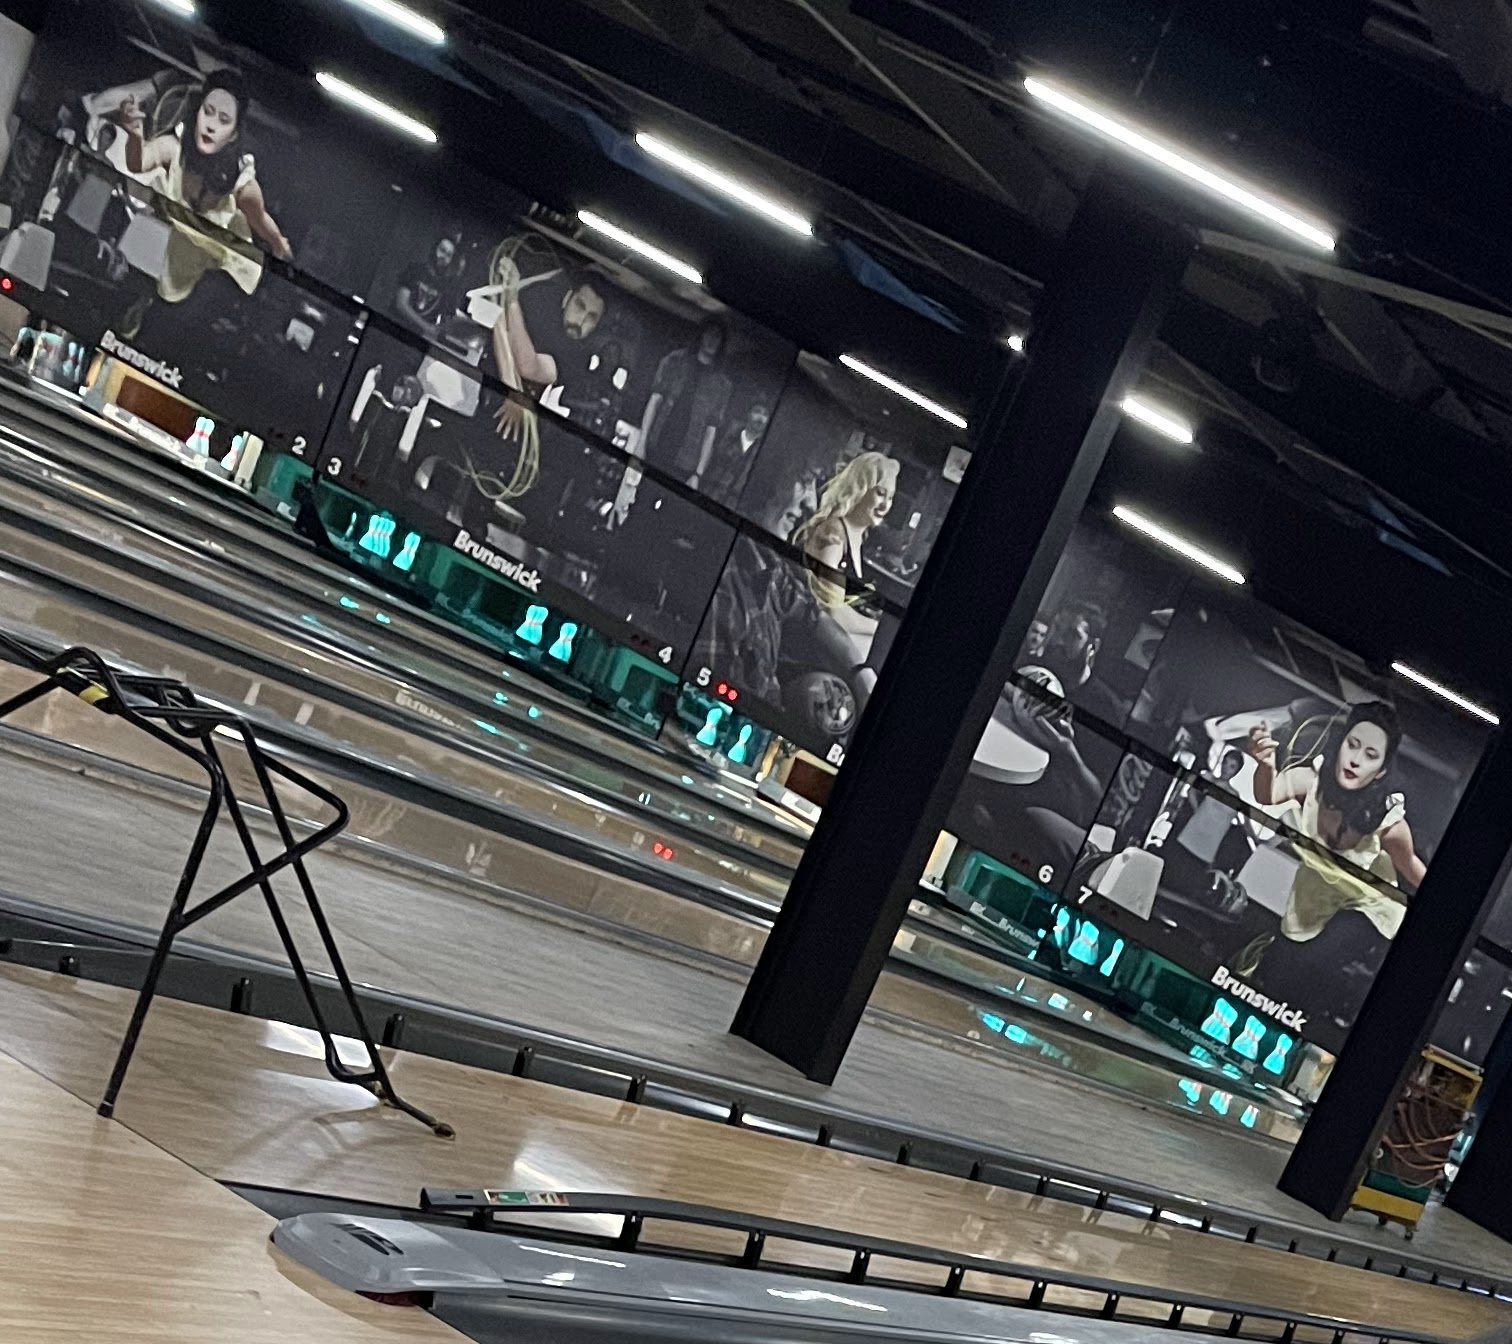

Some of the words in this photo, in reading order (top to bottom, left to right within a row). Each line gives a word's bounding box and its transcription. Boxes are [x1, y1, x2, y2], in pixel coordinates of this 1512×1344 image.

[100, 329, 183, 389] Brunswick
[291, 436, 307, 455] 2
[327, 457, 342, 475] 3
[453, 529, 542, 593] Brunswick
[658, 646, 673, 664] 4
[696, 667, 712, 686] 5
[1038, 864, 1054, 884] 6
[1078, 885, 1093, 904] 7
[1211, 964, 1308, 1032] Brunswick
